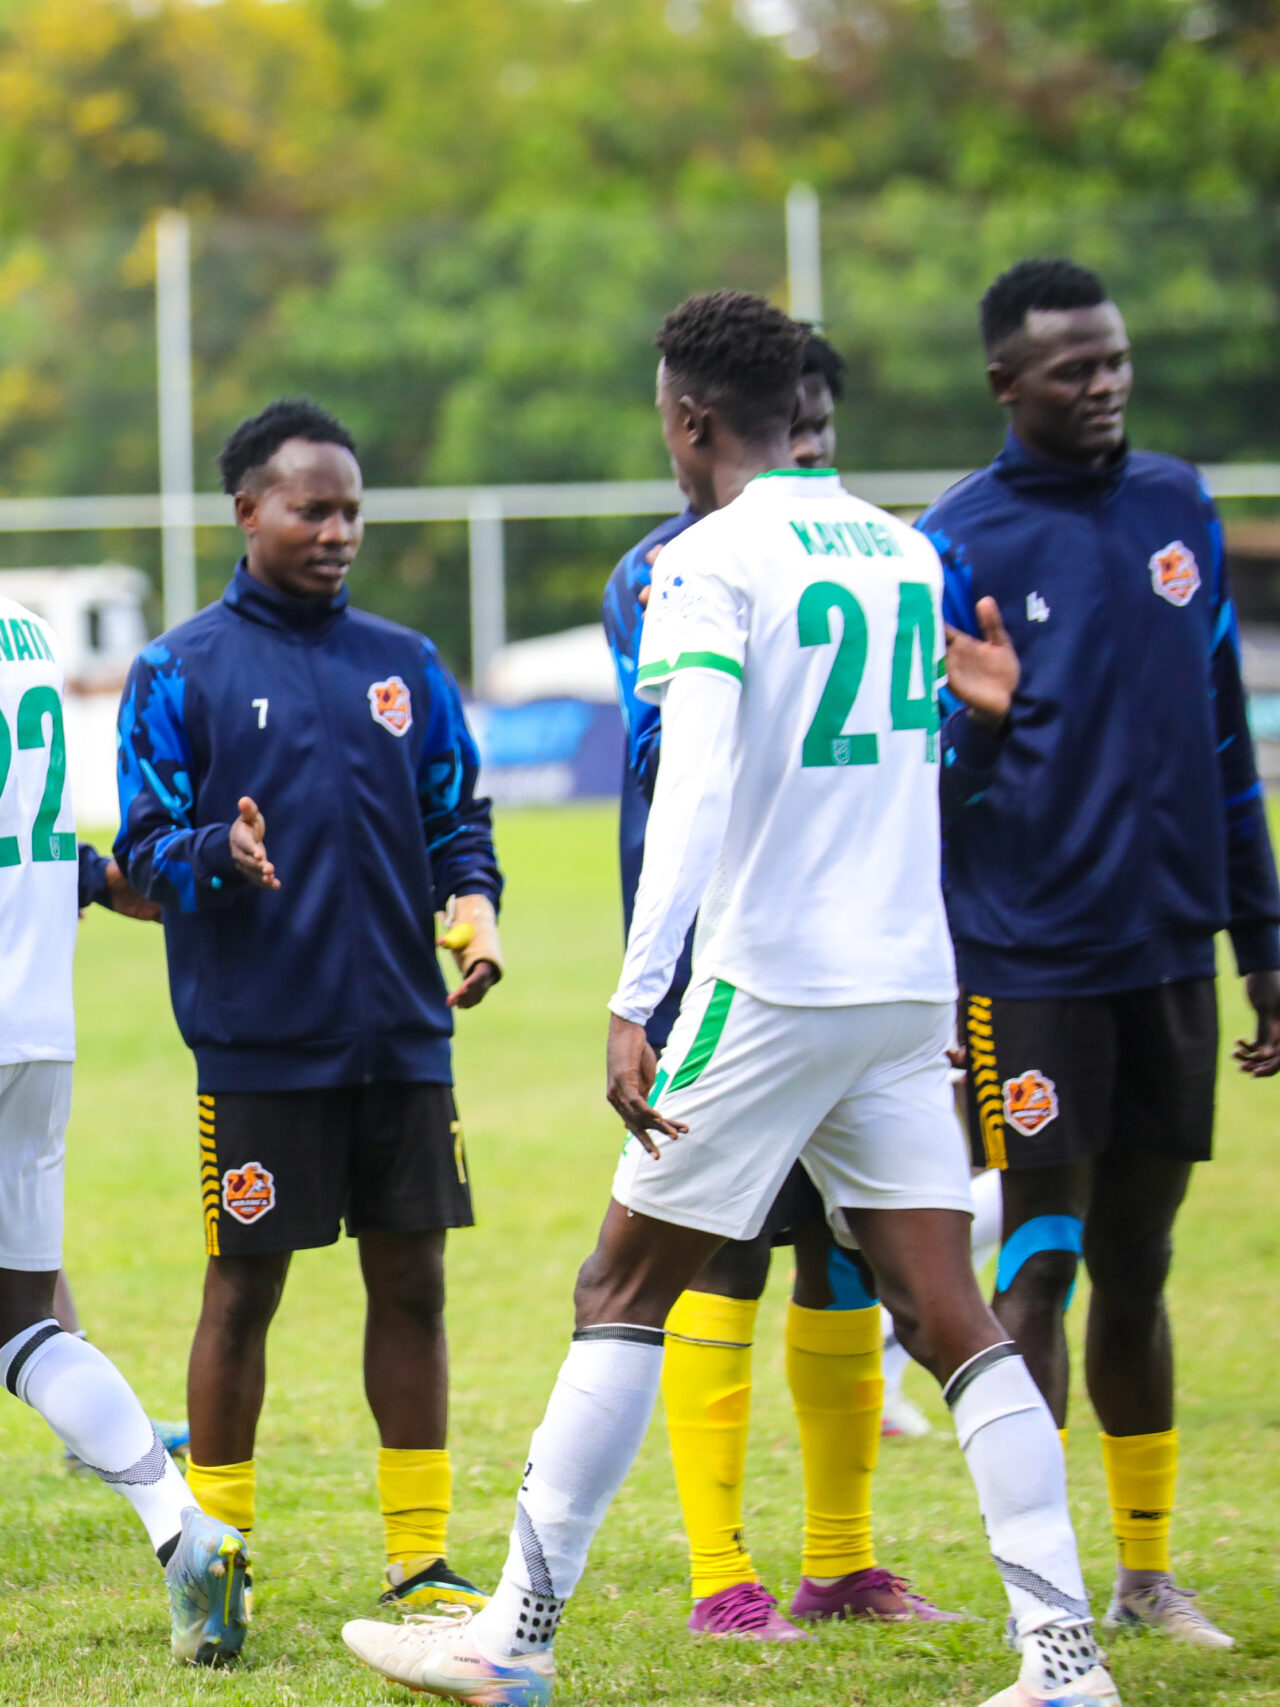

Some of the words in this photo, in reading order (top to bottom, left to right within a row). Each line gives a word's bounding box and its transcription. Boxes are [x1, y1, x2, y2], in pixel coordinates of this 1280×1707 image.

[1026, 591, 1050, 622] 4
[797, 581, 940, 765] 24
[251, 698, 269, 729] 7
